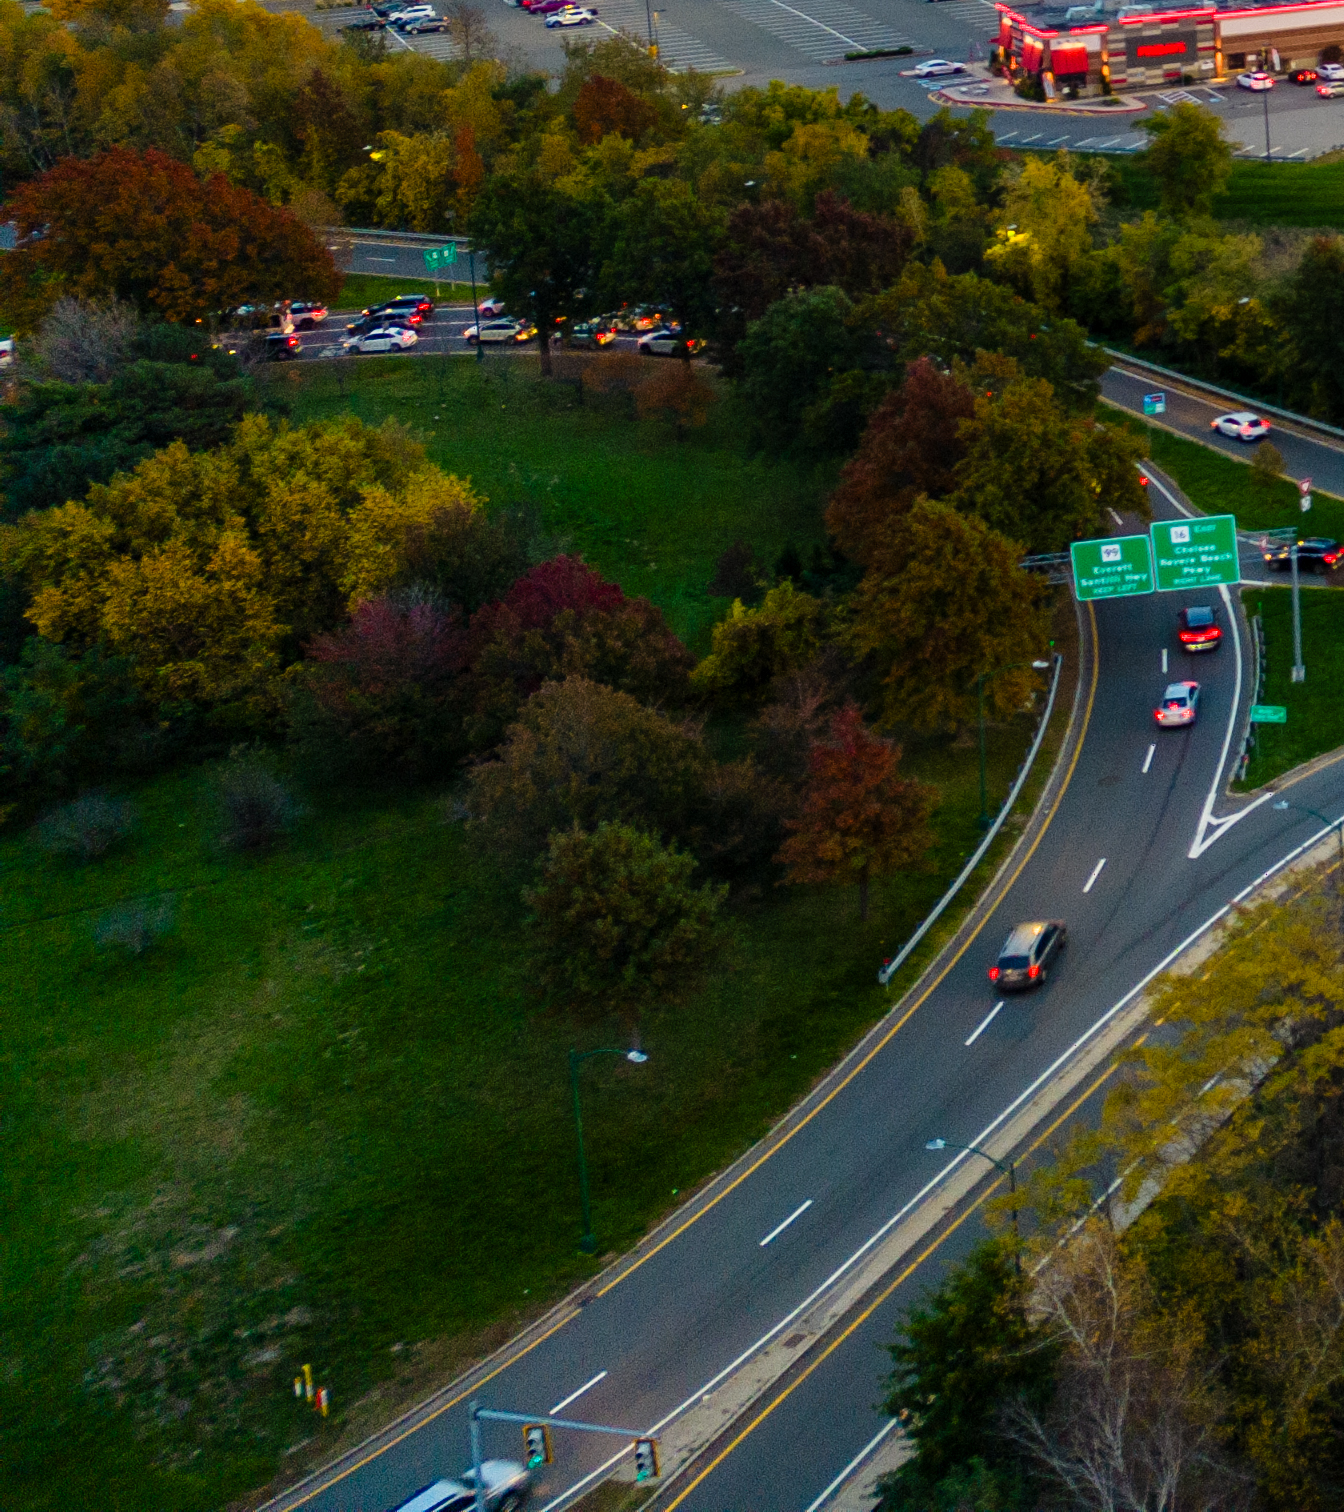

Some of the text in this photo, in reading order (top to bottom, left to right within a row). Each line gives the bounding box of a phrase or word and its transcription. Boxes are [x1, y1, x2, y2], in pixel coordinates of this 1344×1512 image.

[1103, 547, 1120, 558] 99
[1201, 552, 1233, 563] Beach
[1182, 567, 1211, 575] Pkwy
